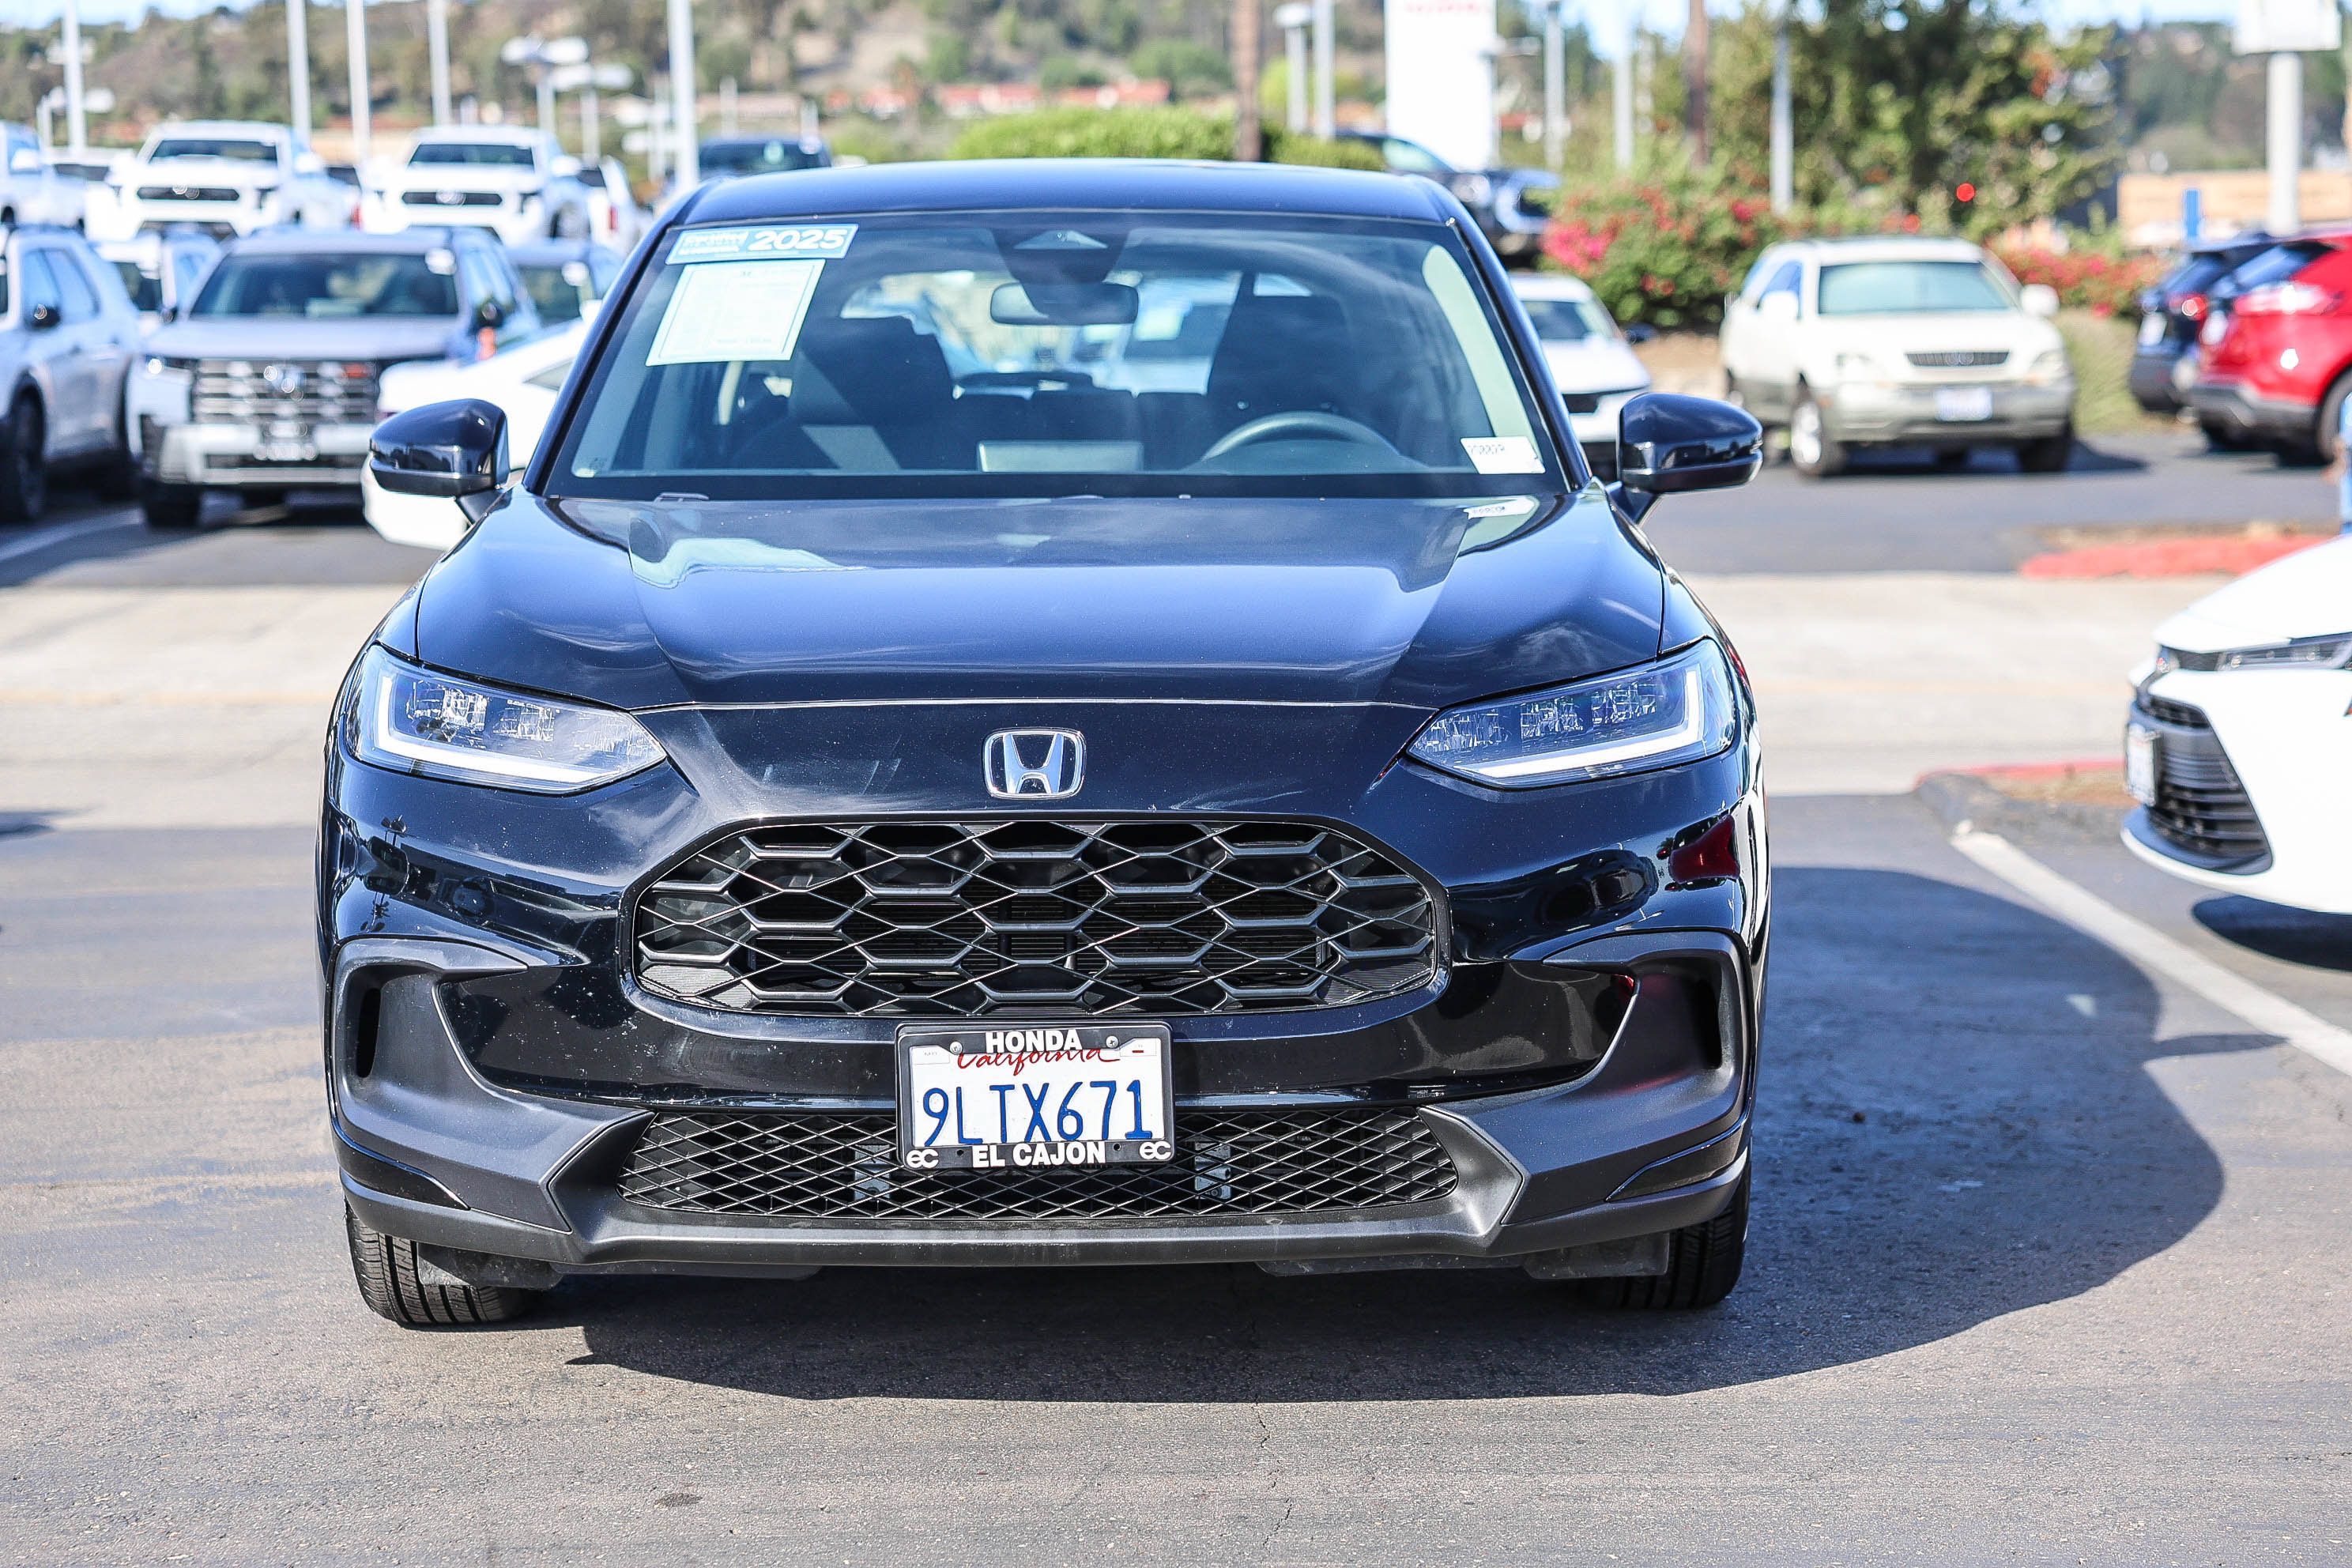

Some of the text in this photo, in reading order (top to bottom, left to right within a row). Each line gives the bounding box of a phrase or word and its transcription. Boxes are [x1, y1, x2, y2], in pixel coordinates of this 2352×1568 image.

[748, 229, 848, 251] 2025
[985, 1030, 1083, 1054] HONDA
[922, 1080, 1152, 1147] 9LTX671
[972, 1140, 1106, 1167] EL CAJON
